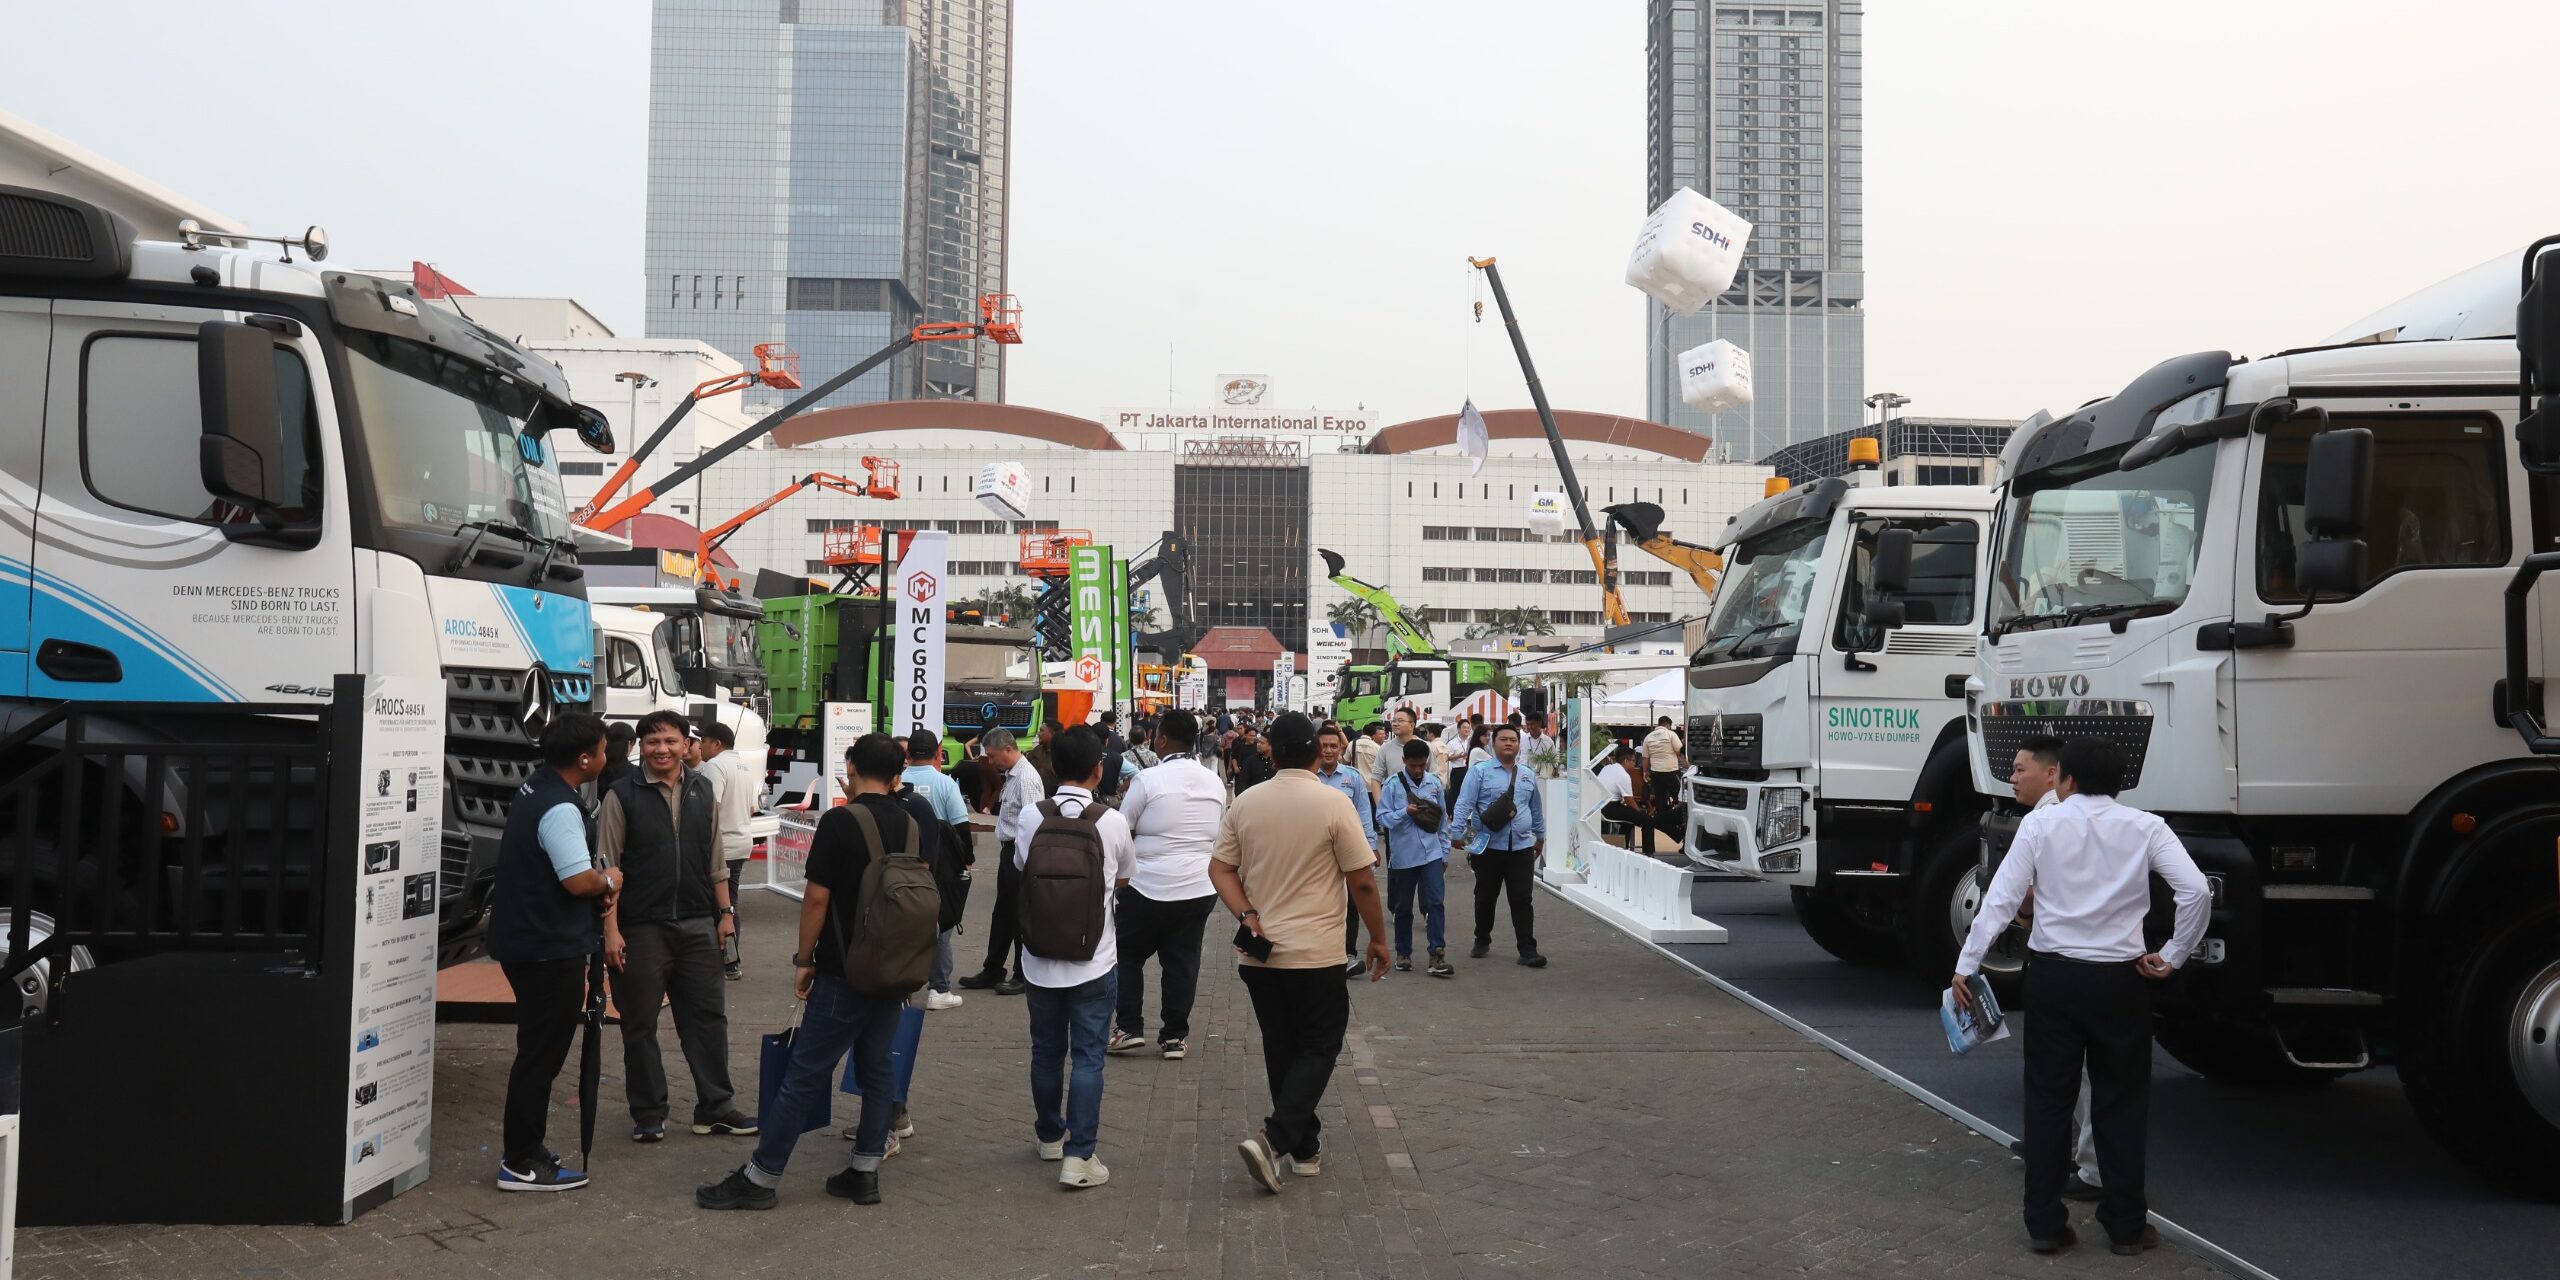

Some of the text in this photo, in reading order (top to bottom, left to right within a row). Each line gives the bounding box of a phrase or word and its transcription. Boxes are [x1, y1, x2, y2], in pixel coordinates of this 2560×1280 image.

[1691, 221, 1731, 252] SDHI
[1689, 362, 1715, 378] SDHI
[1119, 412, 1366, 433] PT Jakarta International Expo
[1537, 498, 1554, 507] GM
[173, 585, 340, 599] DENN MERCEDES-BENZ TRUCKS
[231, 600, 340, 612] SIND BORN TO LAST.
[192, 614, 339, 625] BECAUSE MERCEDES-BENZ TRUCKS
[257, 626, 338, 636] ARE BORN TO LAST.
[444, 618, 499, 639] AROCS 4845 K
[265, 683, 334, 698] 4845
[2009, 673, 2090, 699] HOWO
[375, 698, 426, 716] AROCS 4845 K
[1828, 707, 1920, 729] SINOTRUK
[1875, 732, 1886, 742] EV
[1887, 732, 1921, 743] DUMPER
